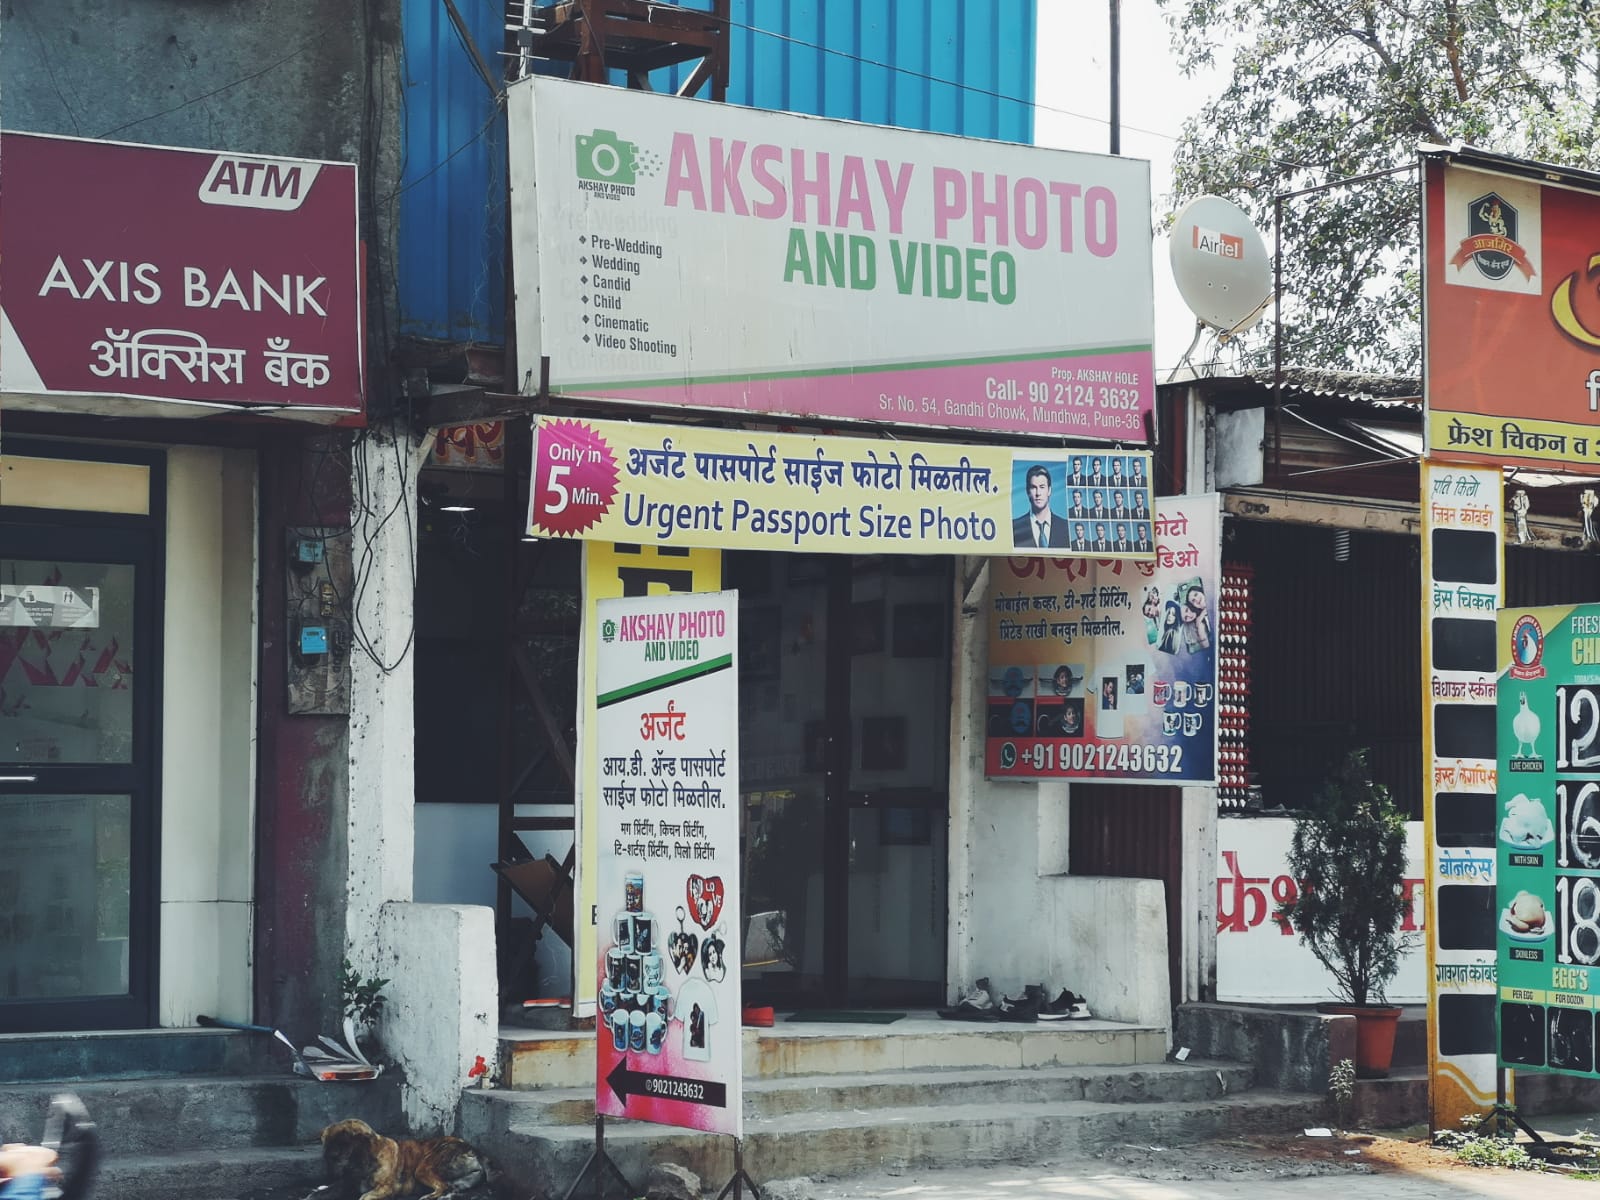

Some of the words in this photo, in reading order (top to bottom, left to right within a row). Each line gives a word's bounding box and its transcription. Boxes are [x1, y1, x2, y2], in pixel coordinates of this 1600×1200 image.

[208, 160, 302, 200] ATM
[578, 180, 609, 192] AKSHAY
[610, 184, 635, 196] PHOTO
[664, 132, 914, 234] AKSHAY
[933, 166, 1118, 258] PHOTO
[591, 234, 663, 258] Pre-Wedding
[1199, 235, 1239, 258] Airtel
[592, 254, 640, 275] Wedding
[783, 227, 876, 291] AND
[889, 239, 1017, 305] VIDEO
[38, 255, 162, 305] AXIS
[184, 266, 328, 317] BANK
[593, 274, 631, 292] Candid
[593, 294, 622, 310] Child
[594, 314, 649, 333] Cinematic
[595, 333, 626, 350] Video
[629, 338, 677, 357] Shooting
[263, 336, 330, 388] बँक
[1051, 367, 1075, 381] Prop.
[1077, 369, 1113, 384] AKSHAY
[1115, 372, 1139, 385] HOLE
[986, 377, 1023, 401] Call-
[1029, 382, 1049, 404] 90
[1054, 384, 1094, 407] 2124
[1100, 388, 1139, 411] 3632
[879, 394, 896, 410] Sr.
[898, 395, 918, 412] No.
[922, 397, 940, 416] 54,
[944, 400, 984, 418] Gandhi
[987, 402, 1029, 423] Chowk,
[1033, 406, 1090, 427] Mundhwa,
[1094, 413, 1140, 430] Pune-36
[1447, 417, 1493, 448] फ्रेश
[1500, 422, 1567, 454] चिकन
[1572, 437, 1589, 456] व
[549, 443, 584, 467] Only
[587, 445, 601, 463] in
[626, 438, 686, 479] अर्जंट
[694, 443, 777, 484] पासपोर्ट
[782, 448, 844, 494] साईज
[851, 450, 902, 491] फोटो
[909, 453, 998, 494] मिळतील.
[544, 465, 570, 514] 5
[572, 487, 604, 505] Min.
[624, 493, 724, 539] Urgent
[732, 499, 851, 544] Passport
[859, 504, 912, 539] Size
[920, 506, 996, 541] Photo
[1456, 585, 1496, 611] चिकन
[620, 612, 675, 642] AKSHAY
[678, 609, 725, 640] PHOTO
[1025, 618, 1048, 638] राखी
[644, 641, 666, 662] AND
[668, 640, 699, 661] VIDEO
[640, 699, 687, 741] अर्जंट
[681, 749, 726, 778] पासपोर्ट
[1022, 743, 1054, 769] +91
[1059, 743, 1183, 773] 9021243632
[1511, 760, 1522, 770] LIVE
[1522, 761, 1543, 771] CHICKEN
[603, 780, 636, 810] साईज
[640, 779, 669, 807] फोटो
[673, 780, 726, 809] मिळतील.
[659, 820, 681, 837] किचन
[1439, 849, 1494, 881] बोनलेस
[1514, 855, 1526, 864] WITH
[1526, 856, 1539, 865] SKIN
[1552, 966, 1589, 992] EGG'S
[1512, 990, 1523, 1000] PER
[1523, 991, 1534, 1001] EGG
[1555, 993, 1566, 1004] FOR
[652, 1078, 705, 1100] 9021243632
